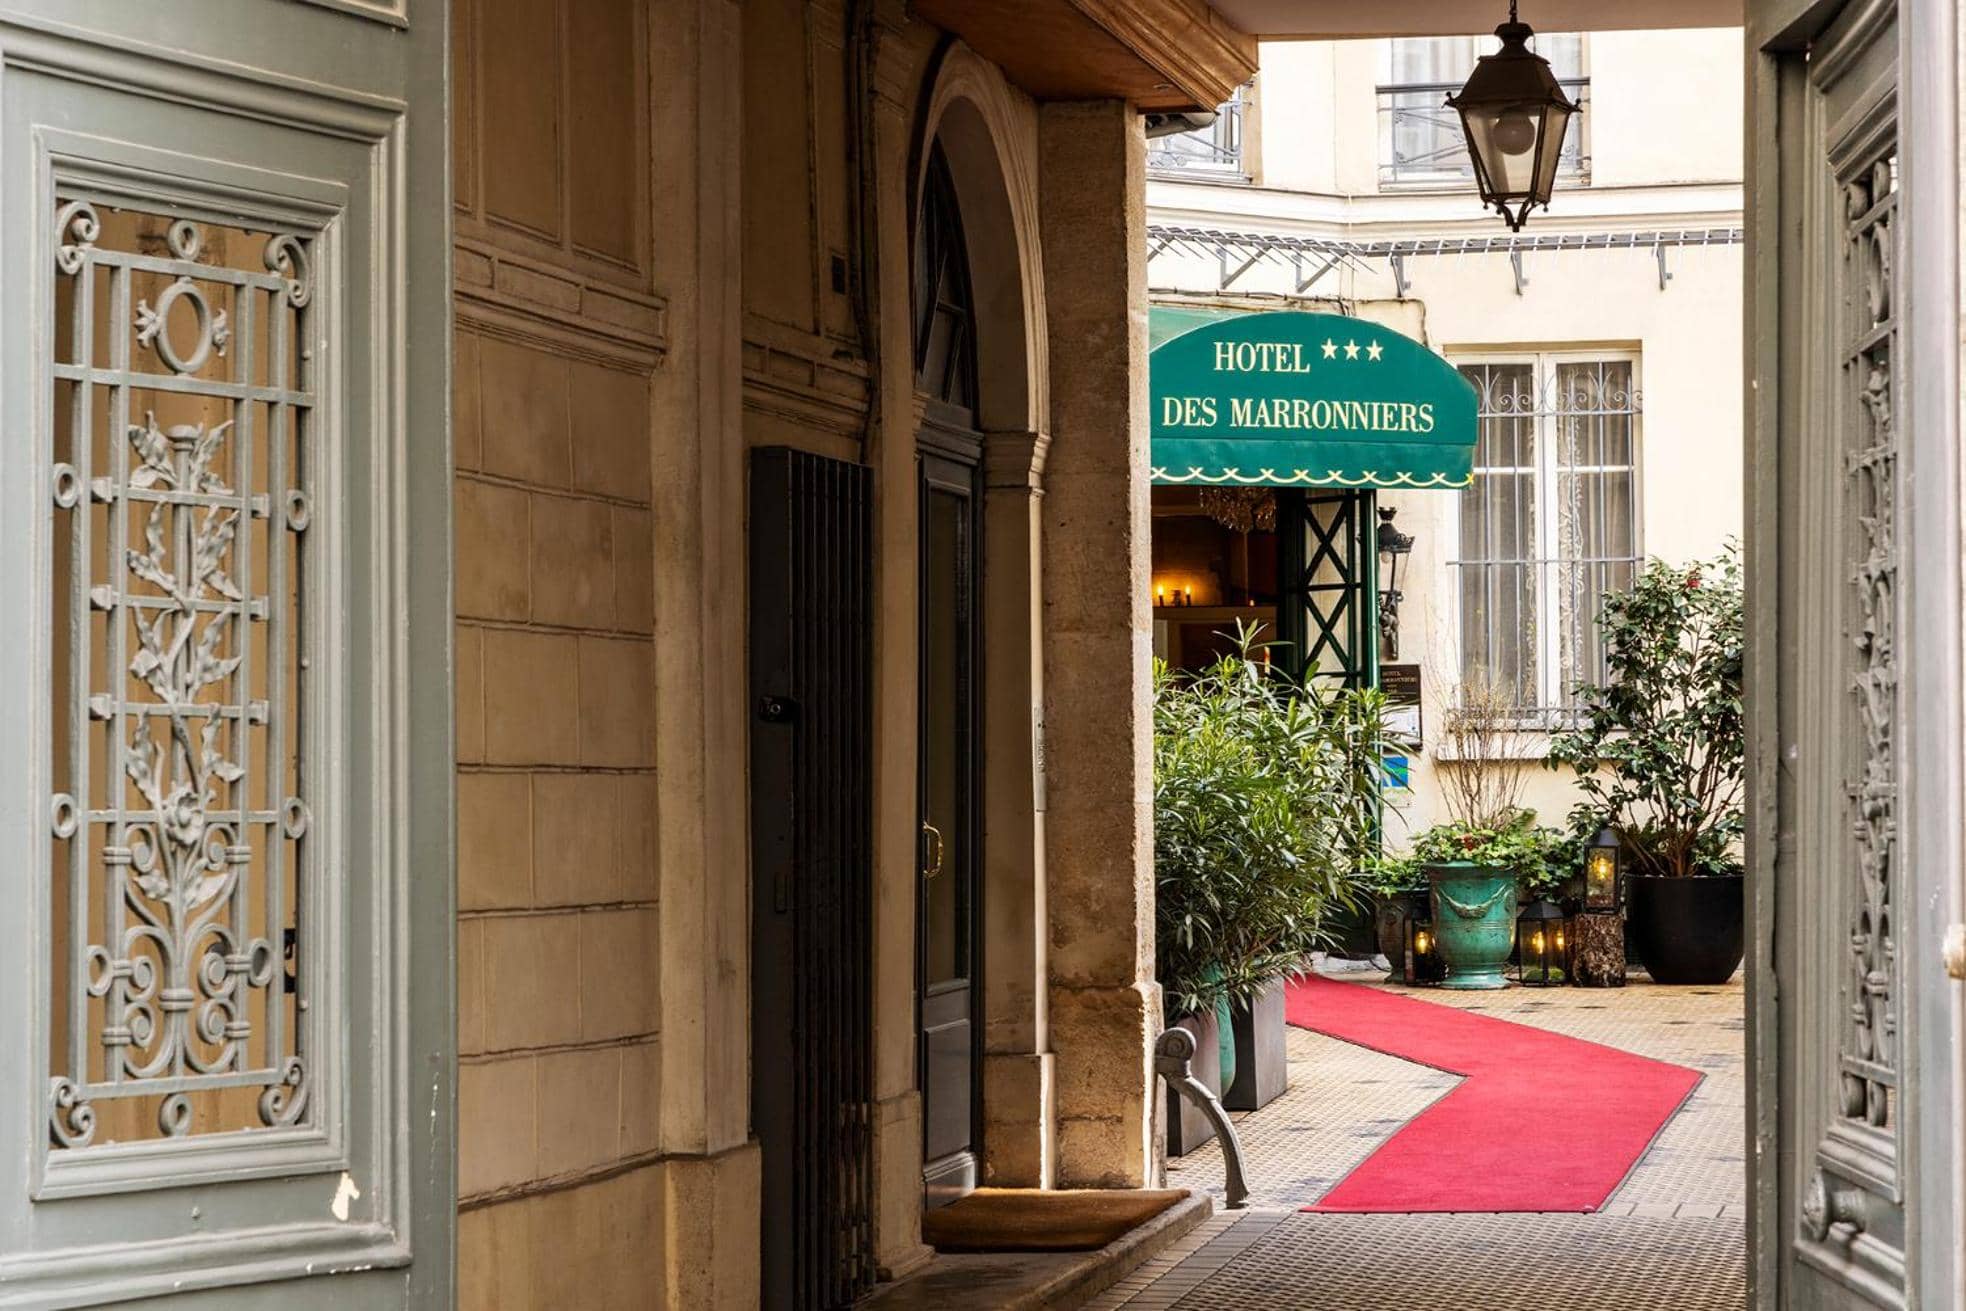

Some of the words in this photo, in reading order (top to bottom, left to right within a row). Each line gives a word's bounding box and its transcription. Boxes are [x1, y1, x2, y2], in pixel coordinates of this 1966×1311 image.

[1215, 342, 1310, 372] HOTEL
[1163, 397, 1217, 426] DES
[1230, 399, 1433, 432] MARRONNIERS
